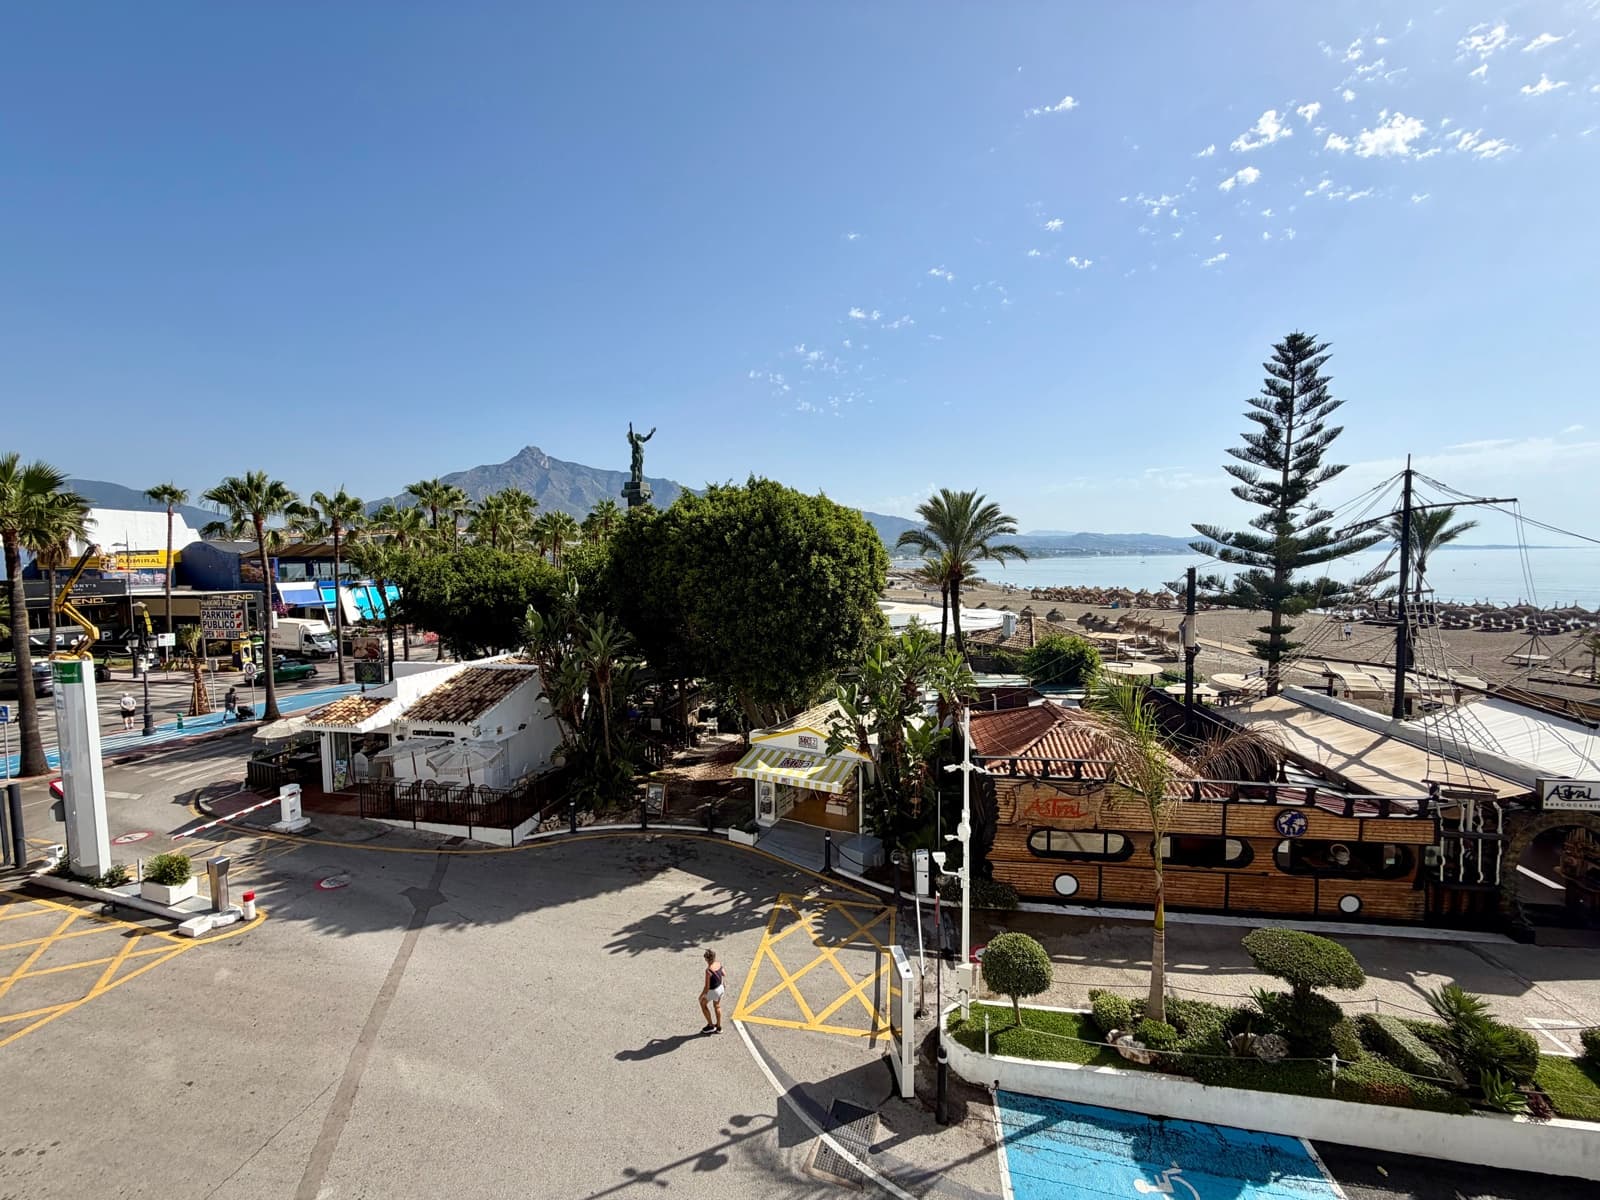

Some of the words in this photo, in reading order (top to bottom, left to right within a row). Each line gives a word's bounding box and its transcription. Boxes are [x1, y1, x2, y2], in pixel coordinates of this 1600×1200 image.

[118, 557, 162, 565] ADMIRAL
[201, 610, 235, 619] PARKING
[202, 620, 236, 629] PUBLICO
